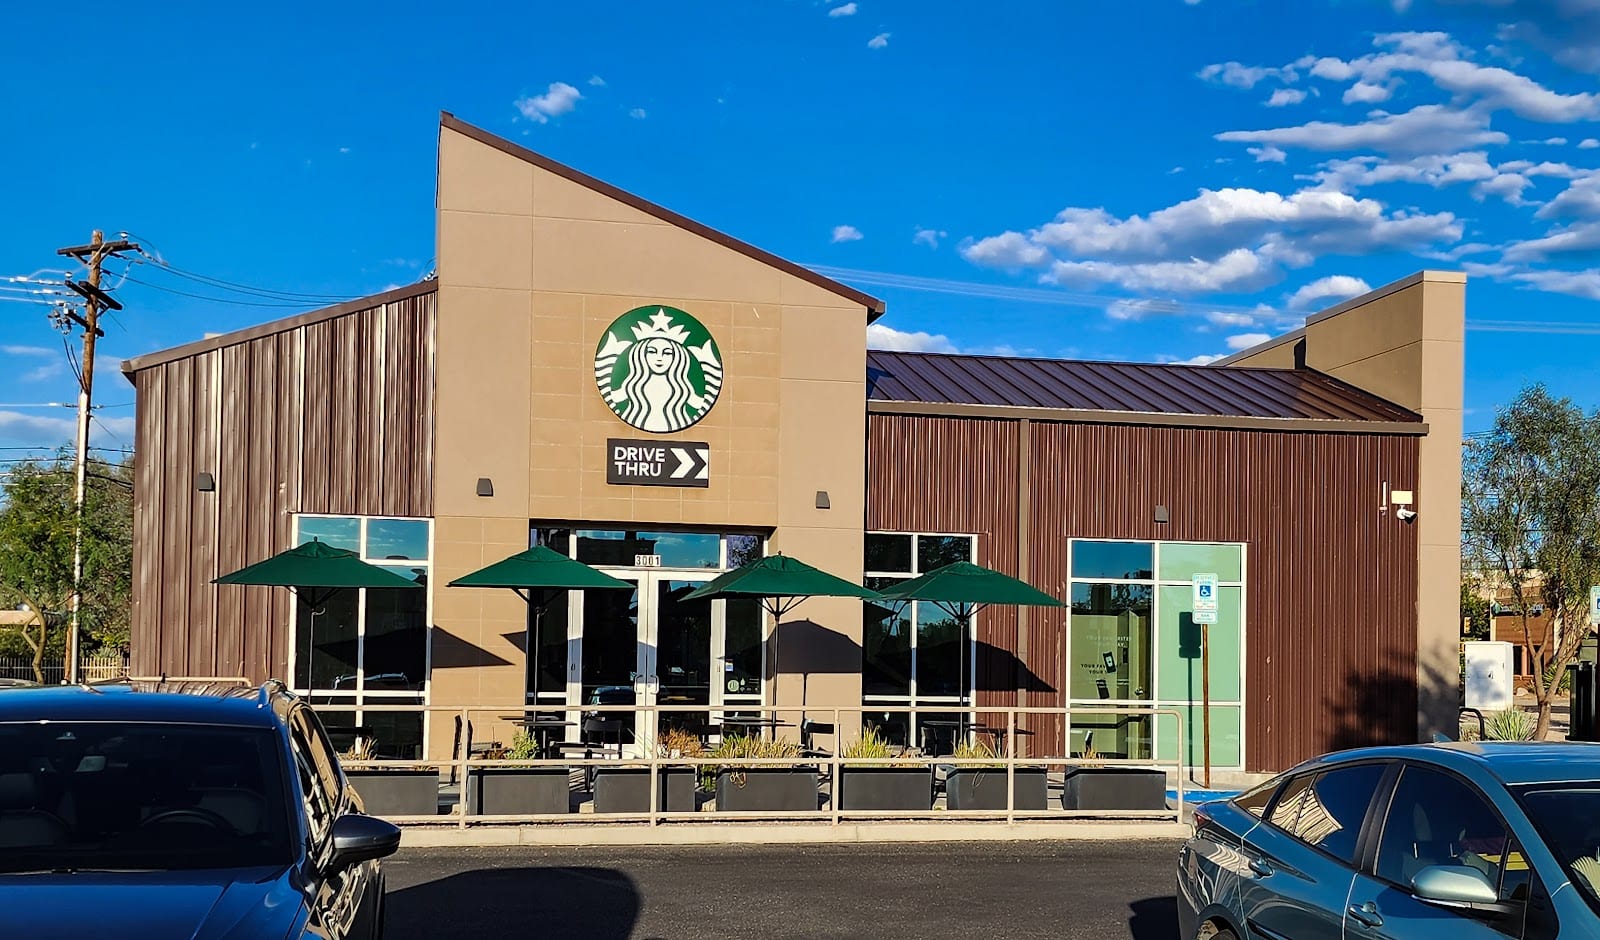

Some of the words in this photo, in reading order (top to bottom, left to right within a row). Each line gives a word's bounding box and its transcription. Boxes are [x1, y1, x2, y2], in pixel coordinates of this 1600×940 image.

[614, 446, 666, 462] DRIVE
[614, 461, 662, 477] THRU
[636, 555, 660, 566] 3001
